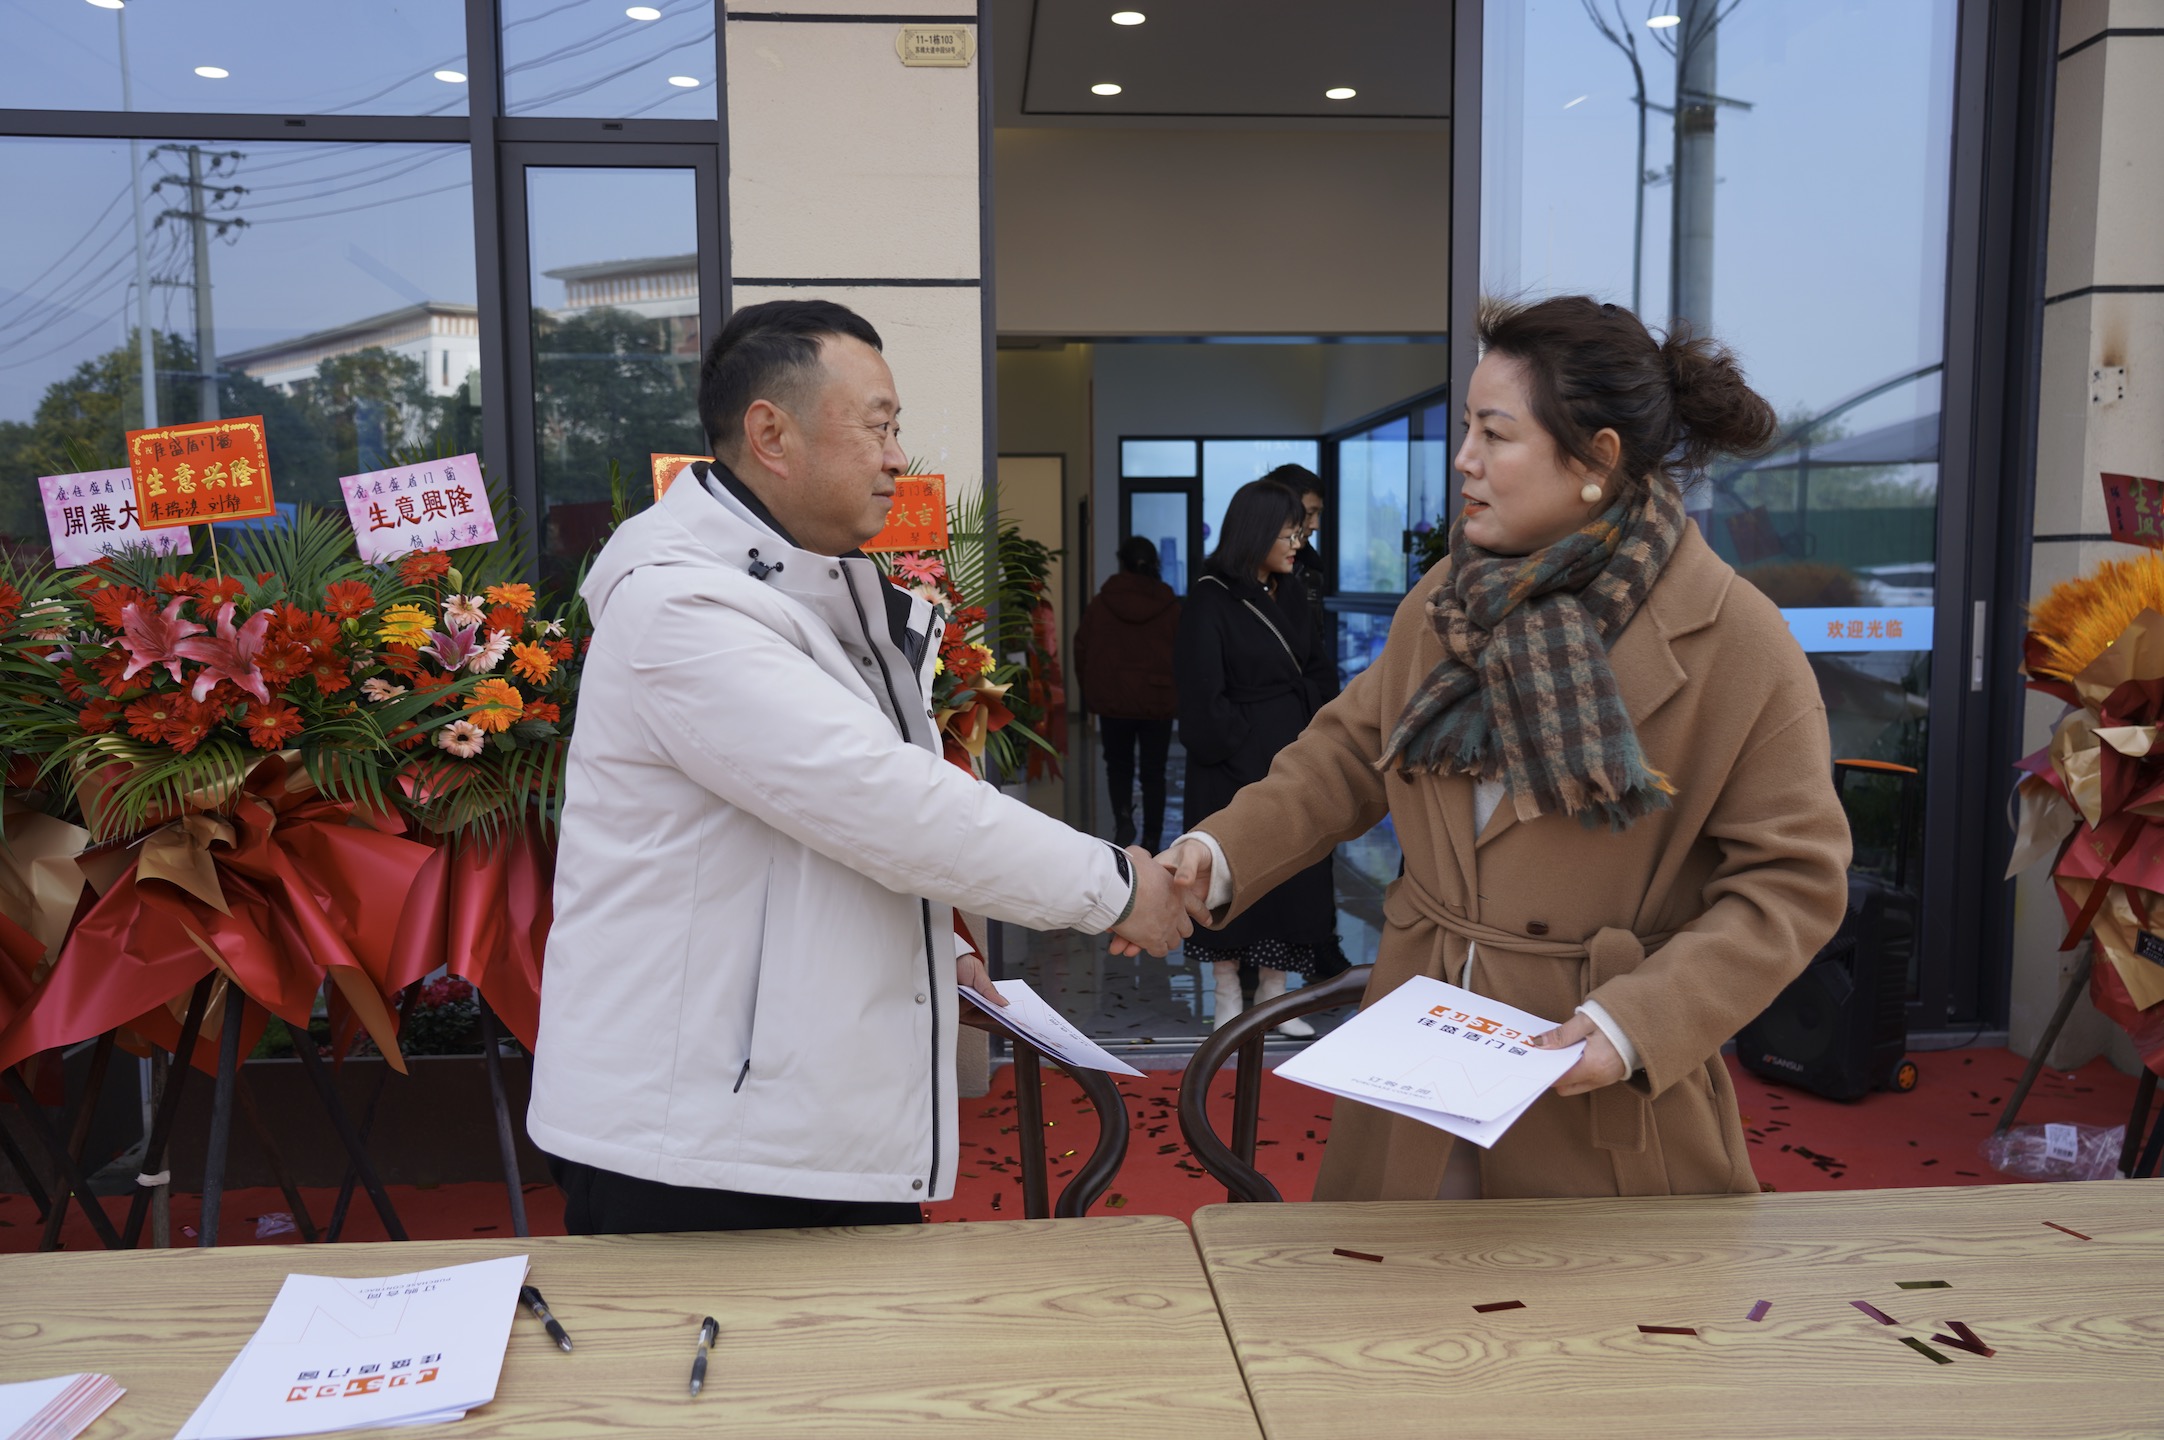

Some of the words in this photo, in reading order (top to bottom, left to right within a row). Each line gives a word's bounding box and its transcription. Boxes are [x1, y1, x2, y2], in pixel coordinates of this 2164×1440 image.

[146, 457, 258, 497] 生意兴隆
[369, 484, 474, 532] 生意興隆
[1827, 619, 1904, 639] 欢迎光临
[1417, 1017, 1528, 1056] 佳盛盾门窗
[285, 1367, 439, 1403] JUSTON
